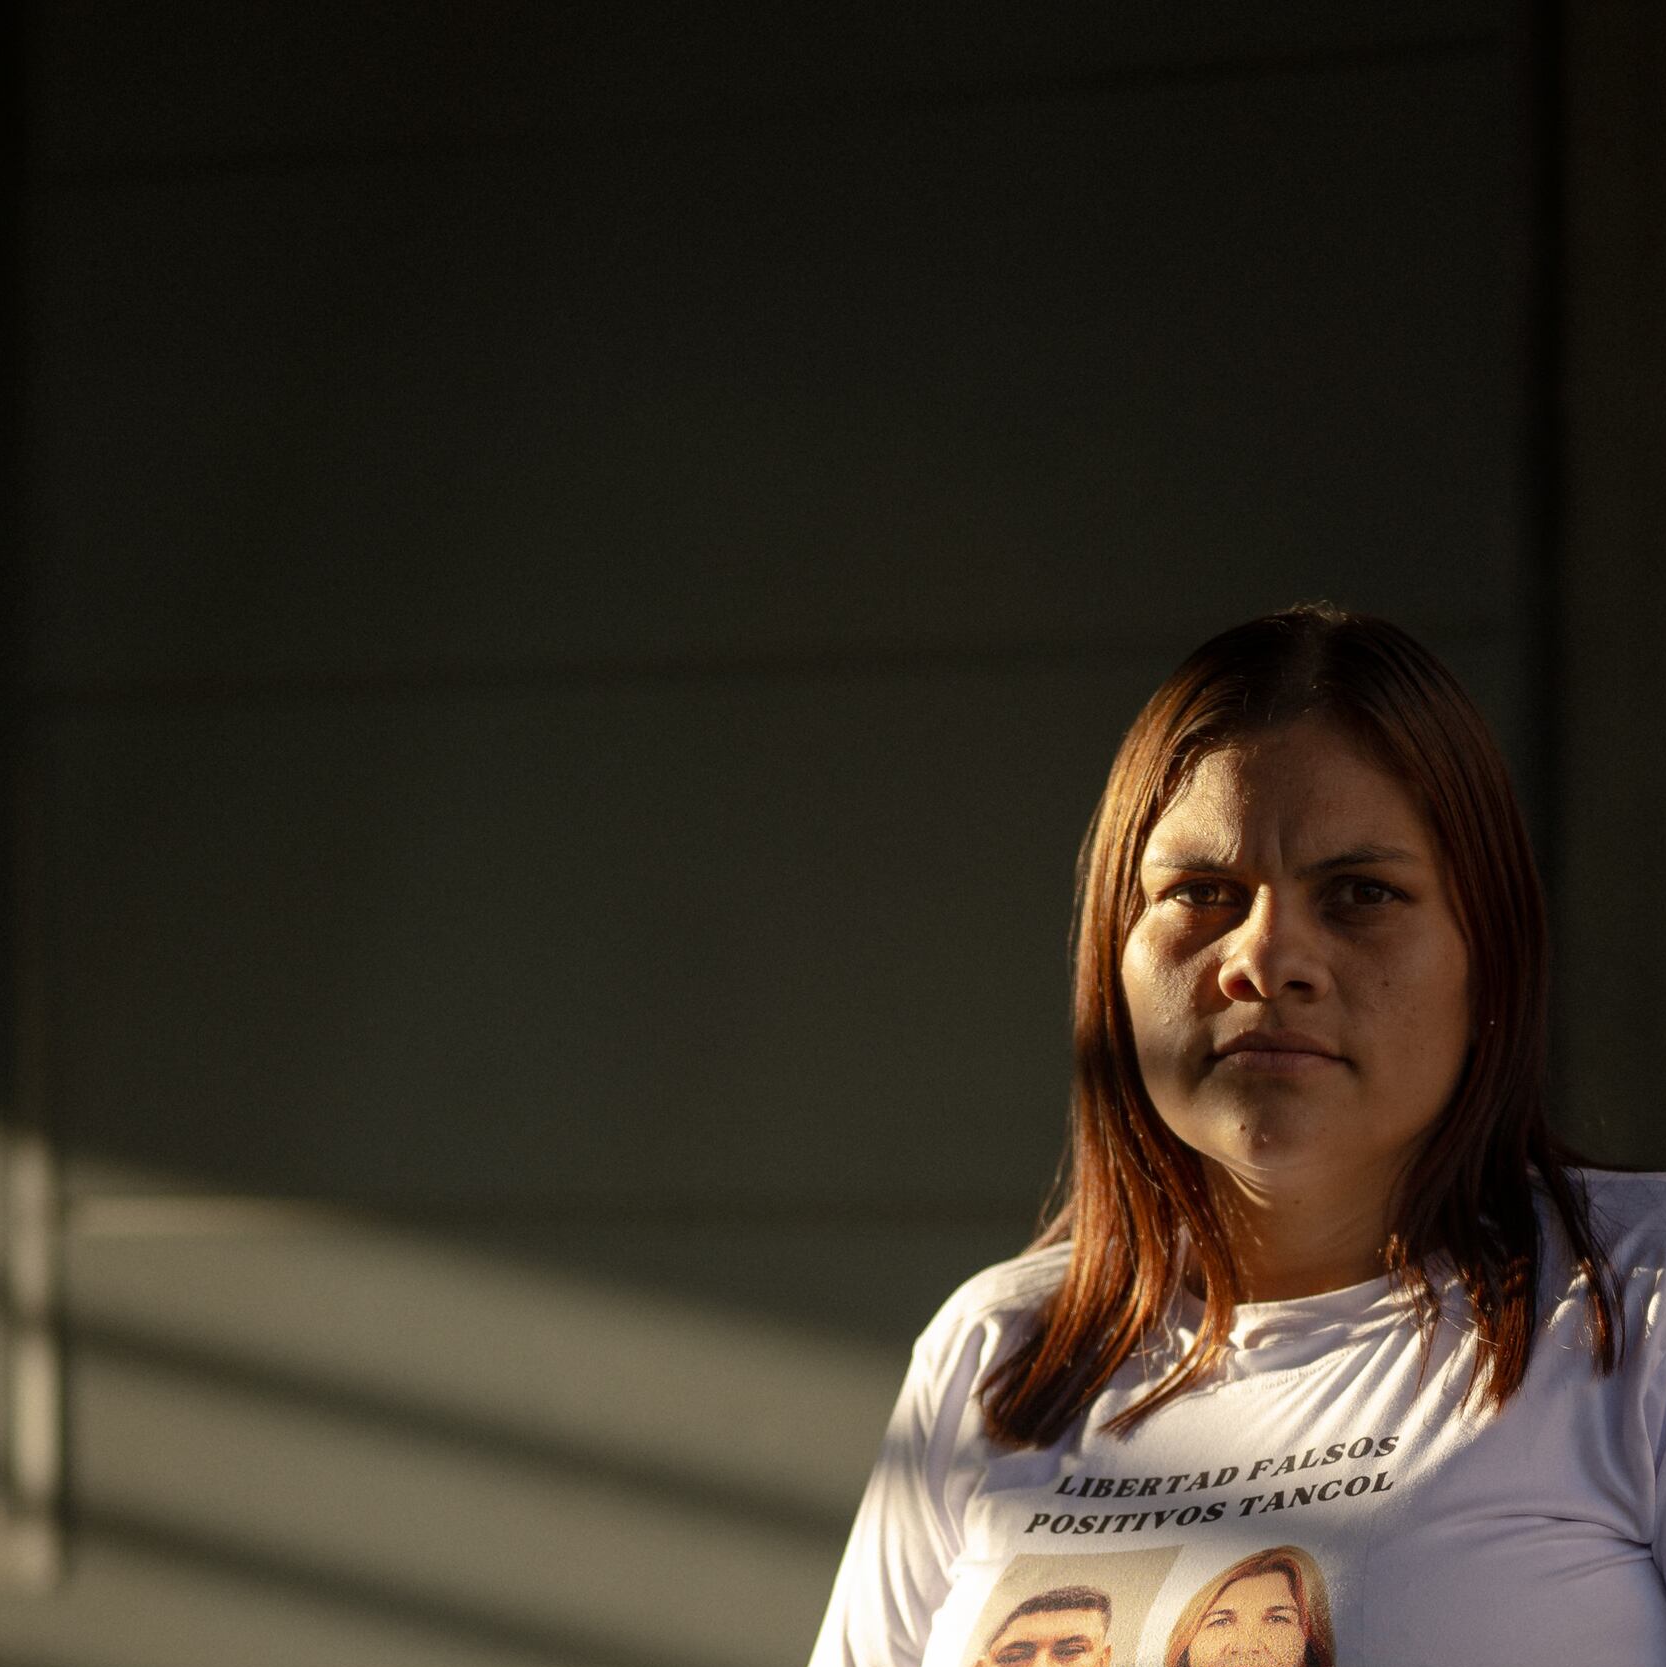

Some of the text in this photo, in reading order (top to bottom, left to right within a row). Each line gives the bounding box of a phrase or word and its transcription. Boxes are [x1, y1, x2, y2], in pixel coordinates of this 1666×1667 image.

[1054, 1434, 1399, 1498] LIBERTAD FALSOS
[1025, 1470, 1394, 1534] POSITIVOS TANCOL
